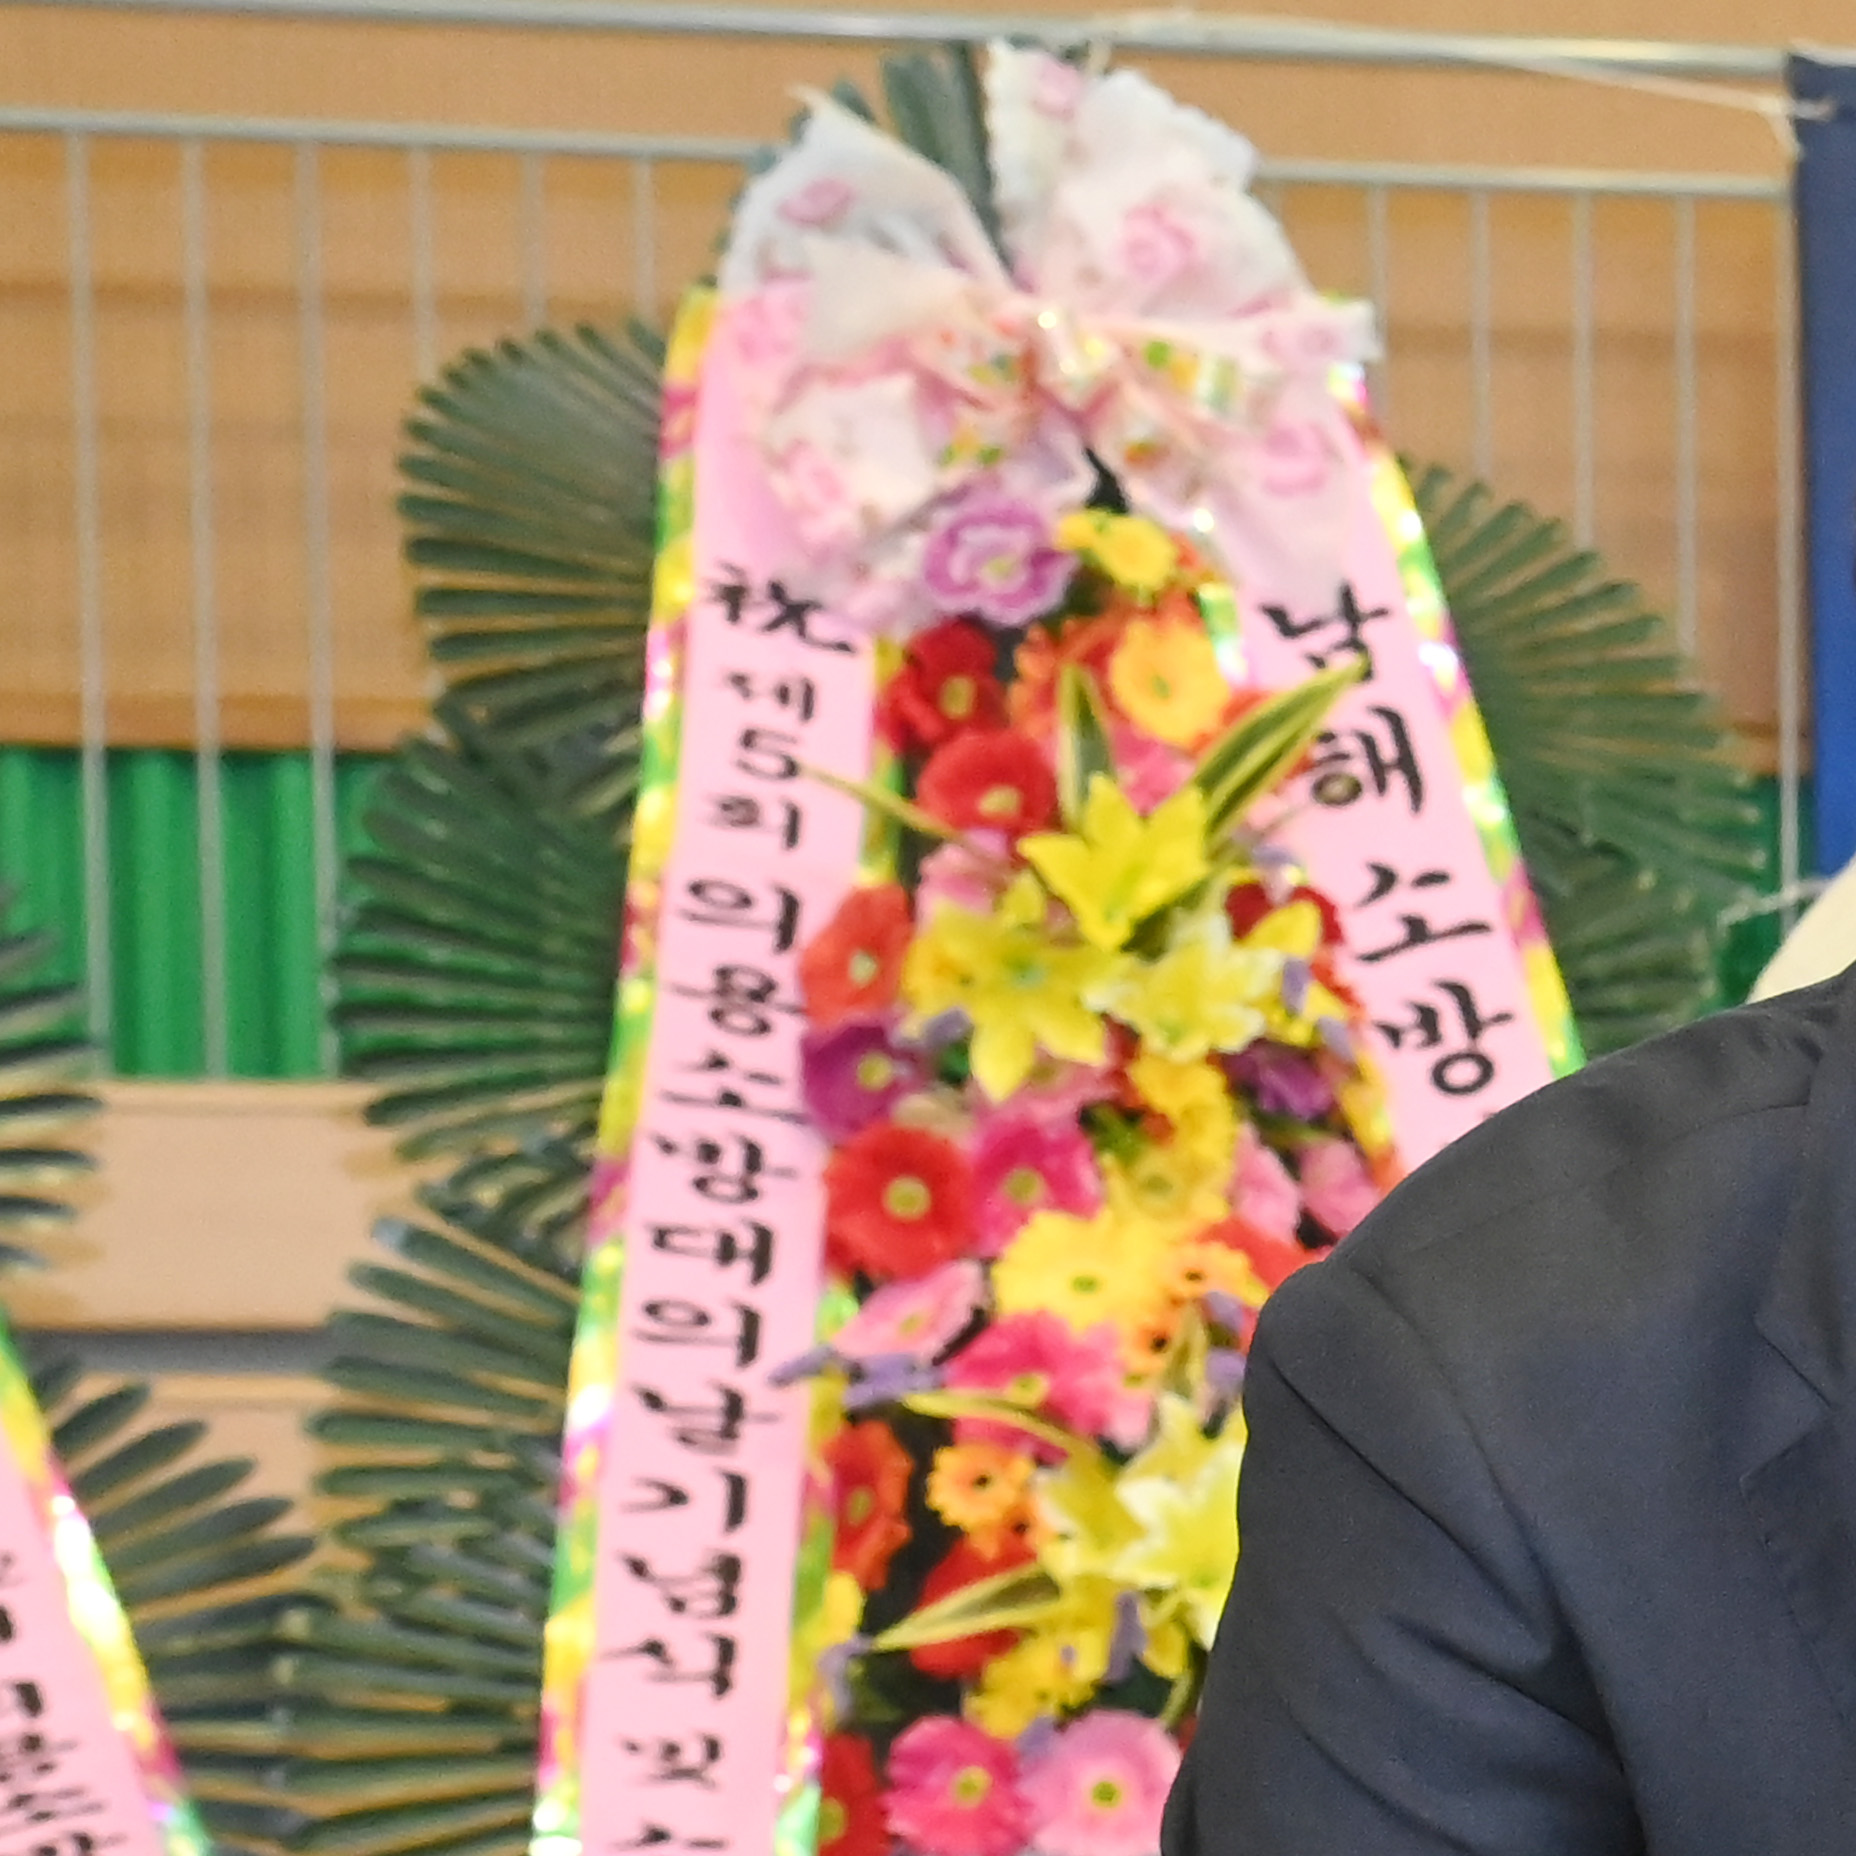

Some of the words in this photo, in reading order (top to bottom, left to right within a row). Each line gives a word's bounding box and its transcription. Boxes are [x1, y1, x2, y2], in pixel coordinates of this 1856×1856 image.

[712, 670, 814, 851] 제5회
[1260, 578, 1514, 1118] 남해소방
[616, 1730, 722, 1793] 및
